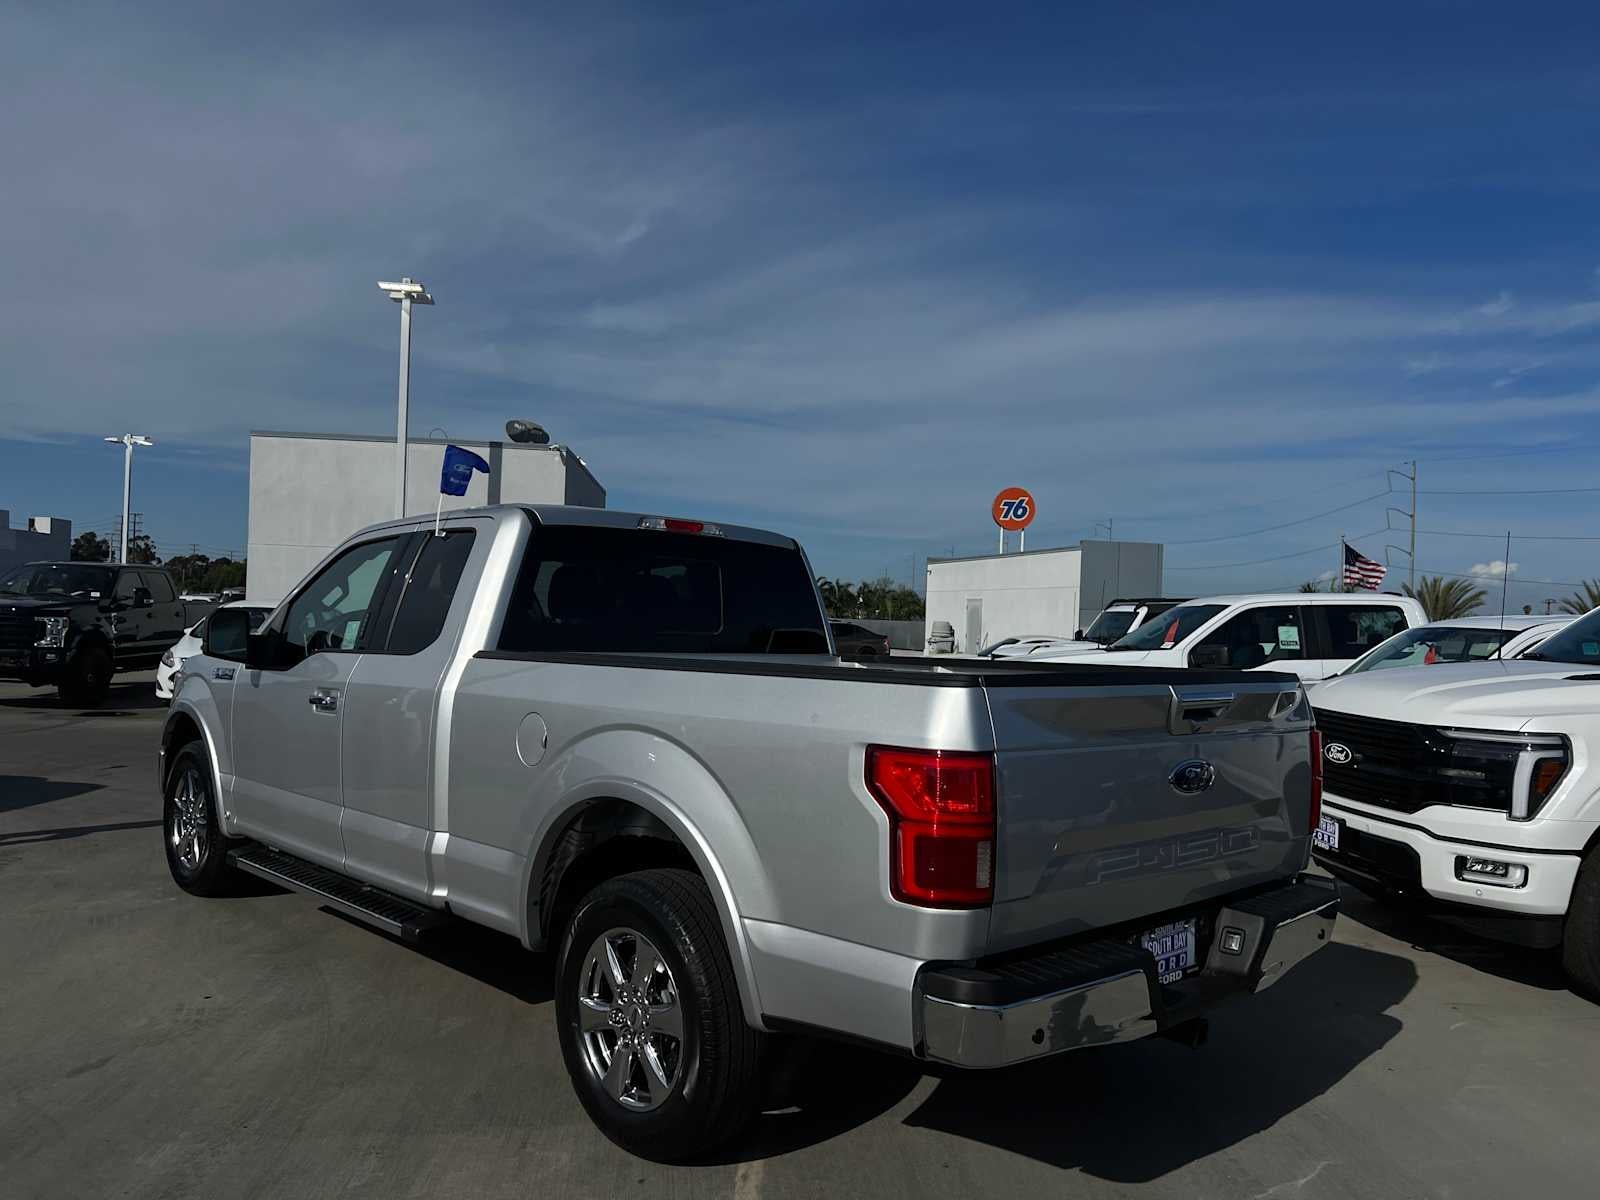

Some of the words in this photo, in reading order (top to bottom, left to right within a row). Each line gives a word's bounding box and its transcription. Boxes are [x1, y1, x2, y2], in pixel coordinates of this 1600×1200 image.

[1000, 497, 1030, 520] 76
[1329, 745, 1347, 761] Ford
[1148, 936, 1172, 957] SOUTH
[1174, 931, 1187, 950] BAY
